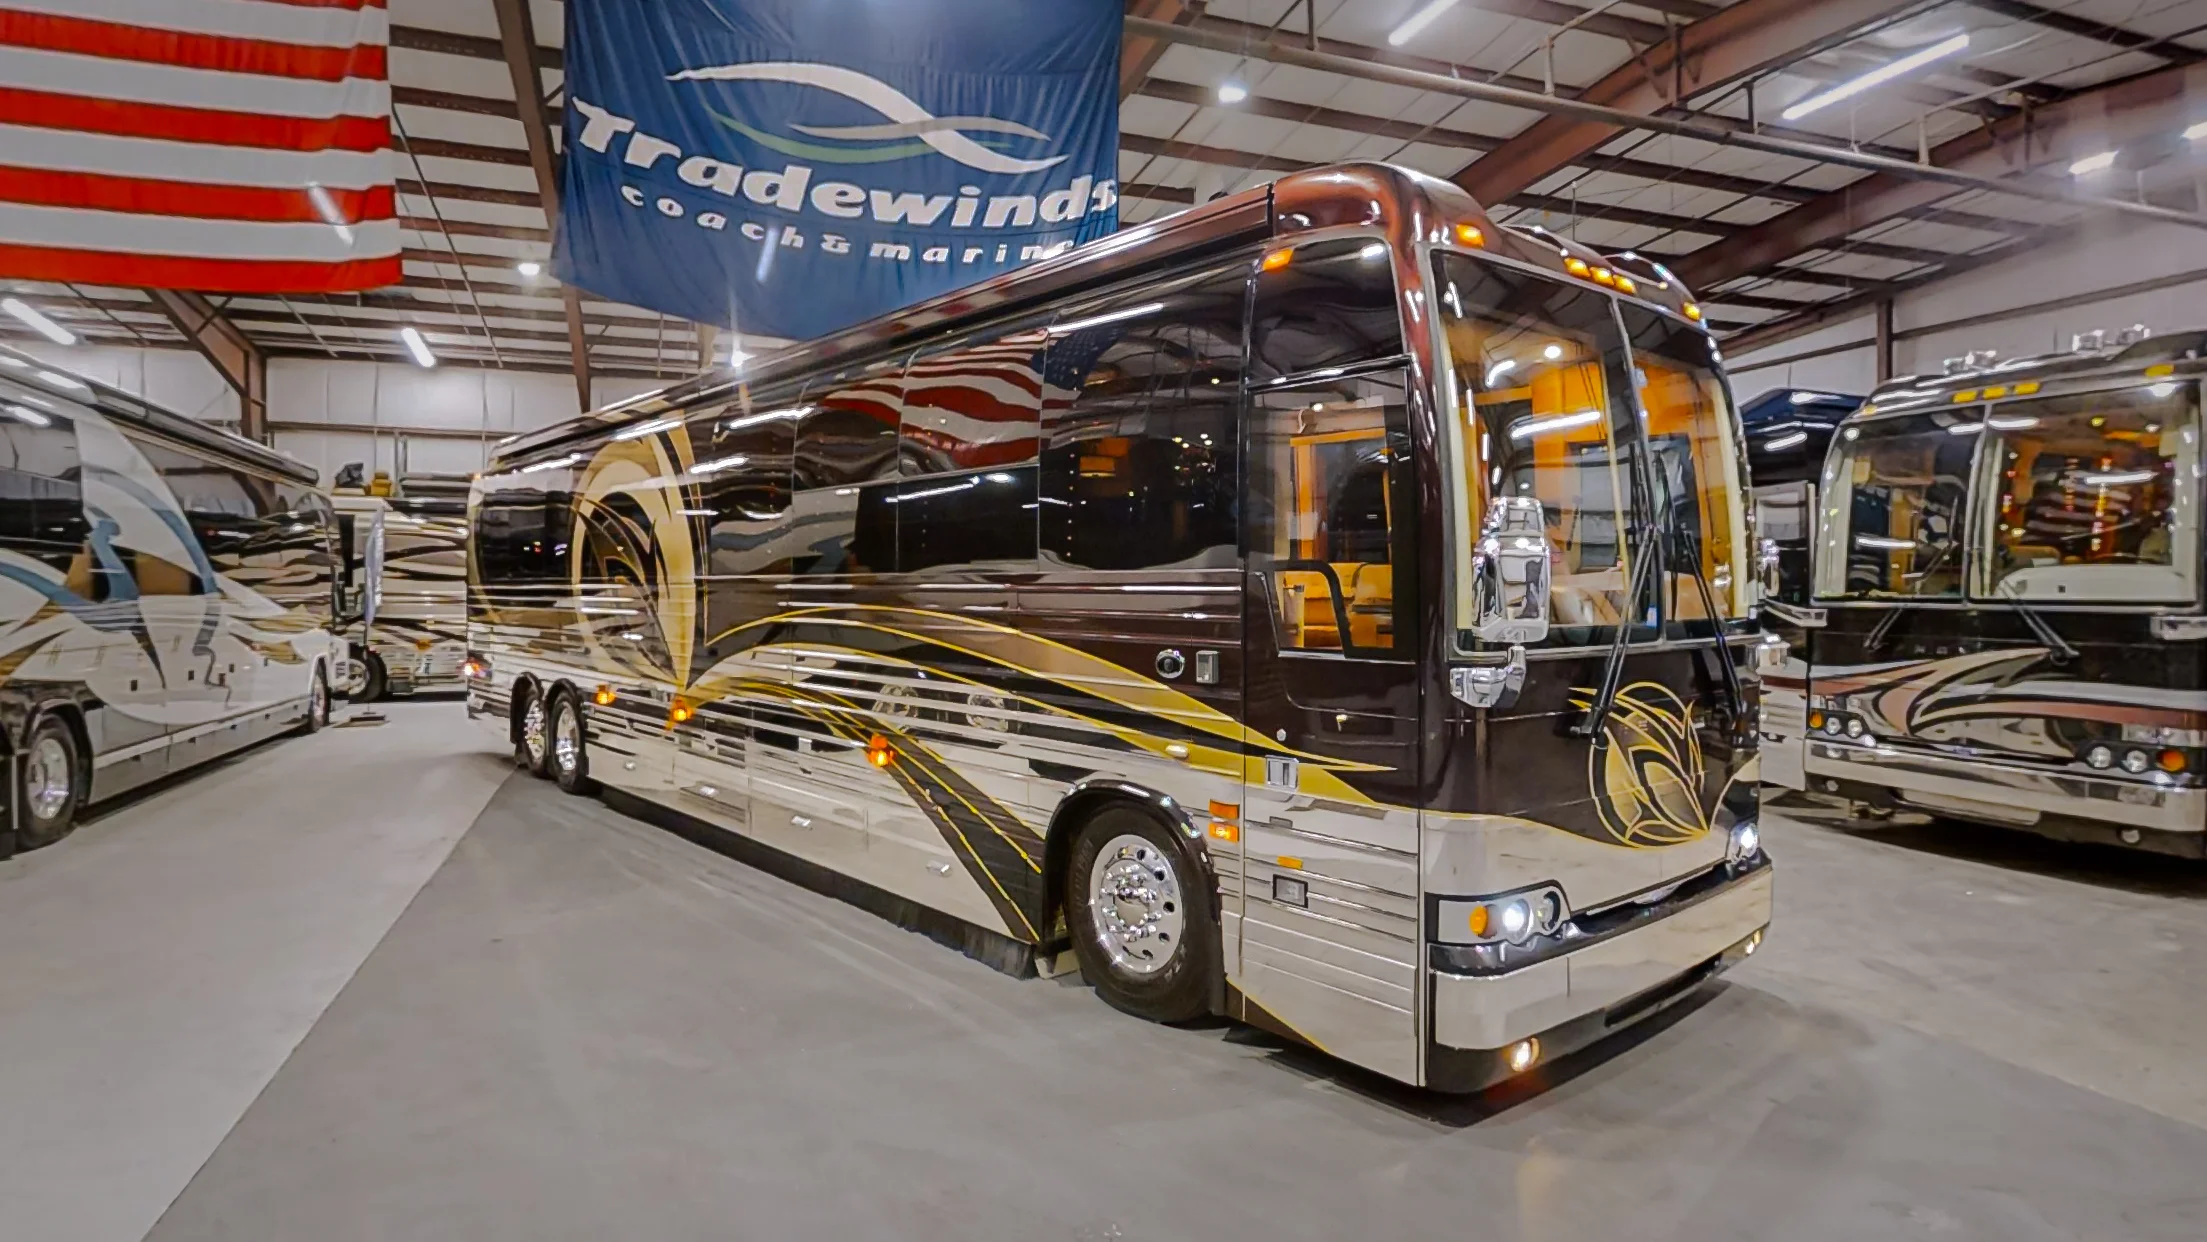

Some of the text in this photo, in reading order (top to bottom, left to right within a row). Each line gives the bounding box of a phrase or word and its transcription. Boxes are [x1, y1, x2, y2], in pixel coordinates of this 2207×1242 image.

[572, 96, 1117, 229] Tradewinds
[621, 185, 805, 249] coach
[820, 232, 851, 254] &
